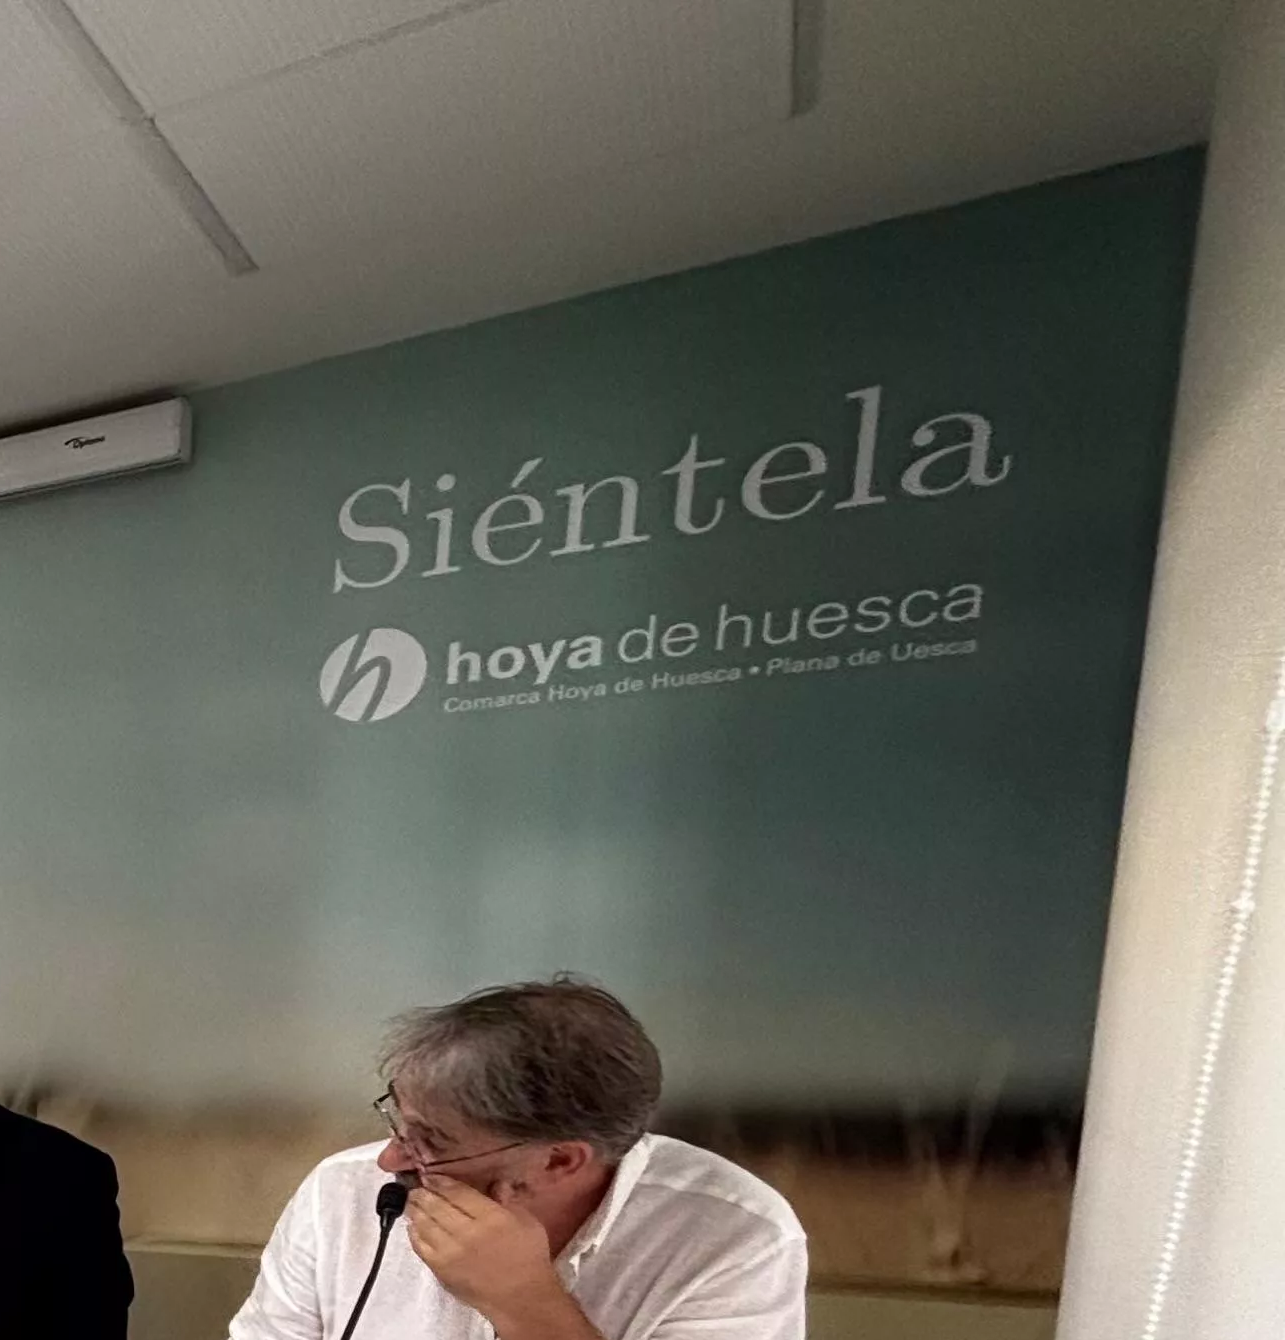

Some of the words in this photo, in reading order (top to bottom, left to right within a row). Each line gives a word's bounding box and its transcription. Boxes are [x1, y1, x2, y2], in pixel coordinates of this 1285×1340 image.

[332, 384, 1012, 594] Siéntela
[443, 690, 542, 712] Comarca
[547, 683, 607, 702] Hoya
[614, 677, 644, 694] de
[651, 668, 742, 689] Huesca
[766, 656, 840, 676] Plana
[846, 648, 882, 666] de
[891, 639, 977, 661] Uesca
[446, 636, 603, 686] hoya
[618, 614, 700, 665] de
[715, 582, 985, 652] huesca
